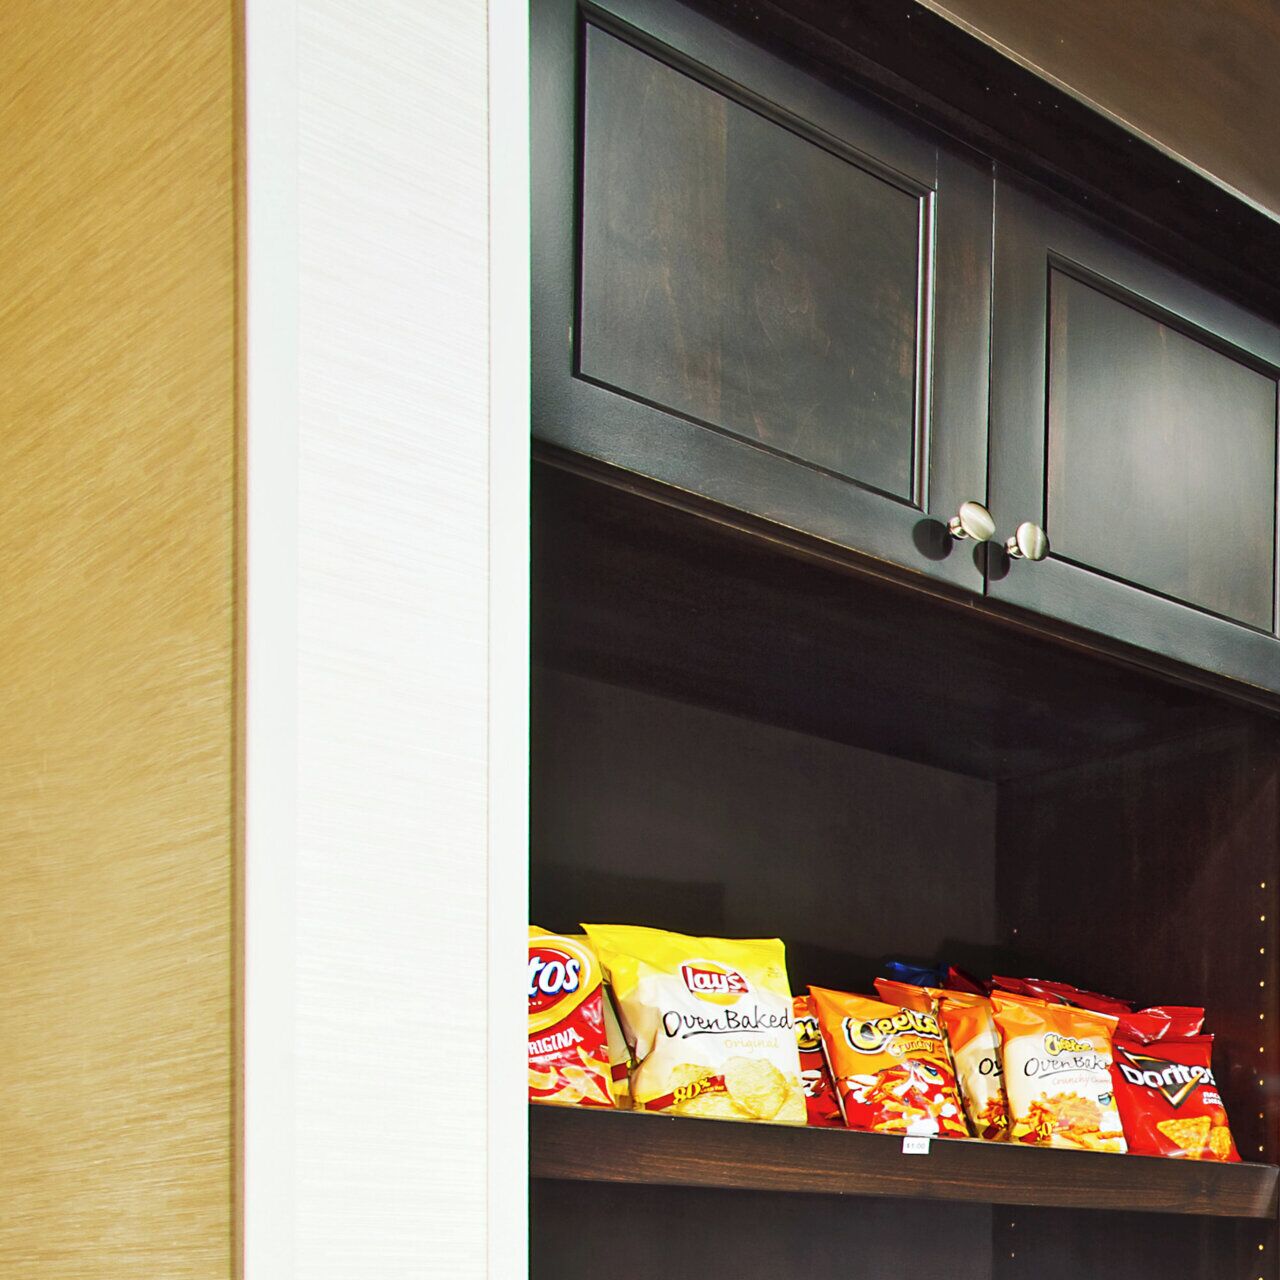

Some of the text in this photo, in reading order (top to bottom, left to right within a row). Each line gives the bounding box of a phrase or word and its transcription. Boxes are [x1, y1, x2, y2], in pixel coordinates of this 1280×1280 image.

[684, 965, 749, 994] Lay's
[662, 1005, 793, 1039] Oven Baked
[1023, 1057, 1071, 1078] Oven
